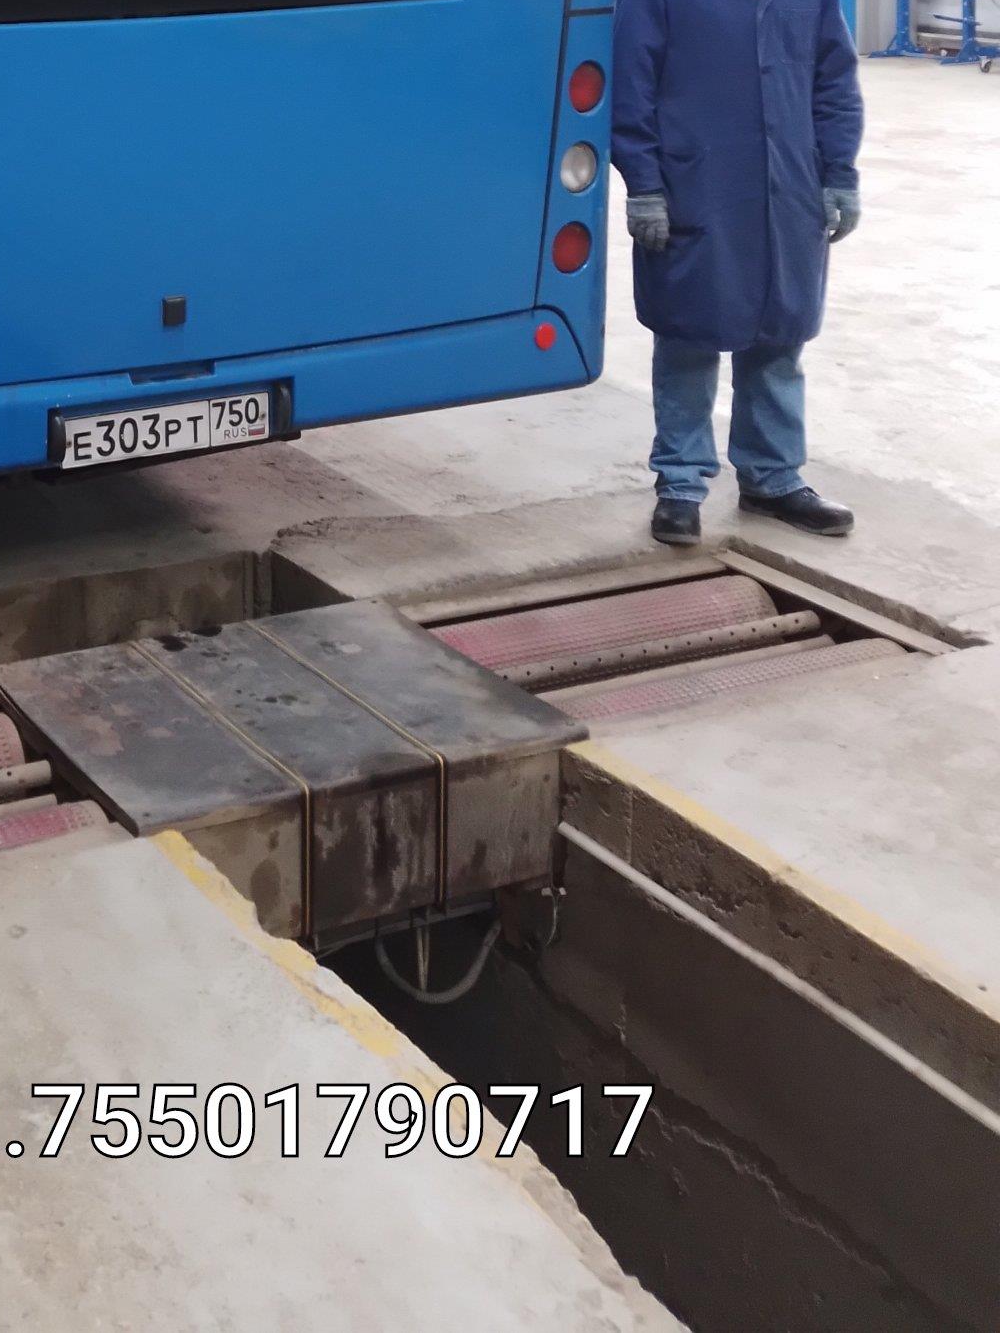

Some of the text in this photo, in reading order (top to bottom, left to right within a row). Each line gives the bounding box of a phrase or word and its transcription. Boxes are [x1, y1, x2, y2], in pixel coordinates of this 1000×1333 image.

[73, 397, 260, 461] Е303РТ 750
[223, 428, 248, 440] RUS
